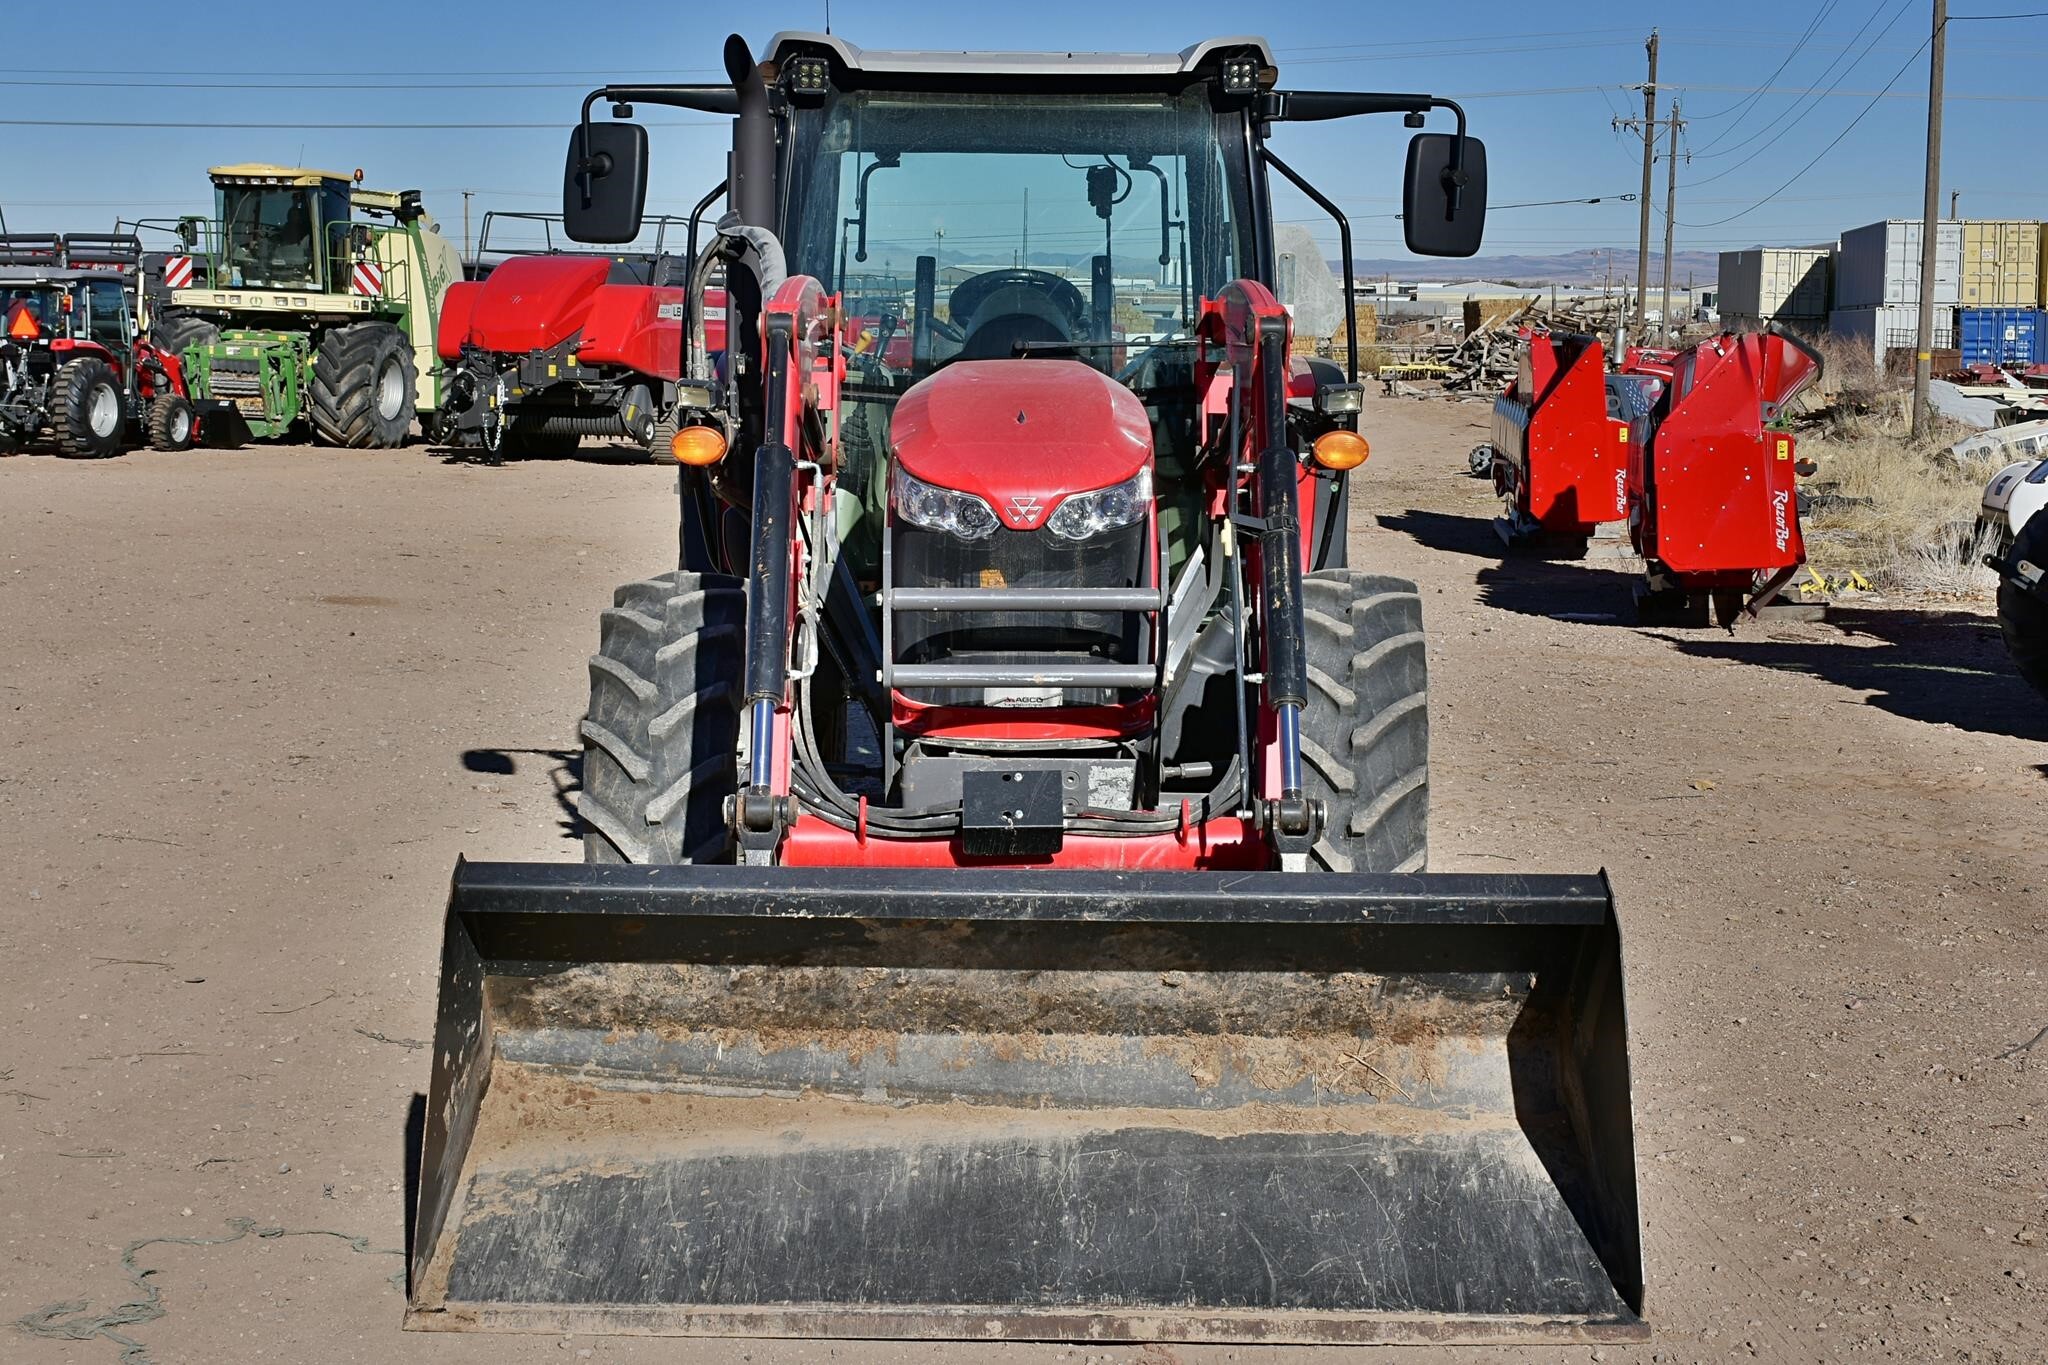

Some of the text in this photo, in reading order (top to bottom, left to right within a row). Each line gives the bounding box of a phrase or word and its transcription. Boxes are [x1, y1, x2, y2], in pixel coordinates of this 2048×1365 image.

[672, 306, 682, 317] LB
[1614, 468, 1627, 515] RazorBar
[1772, 489, 1790, 554] RazorBar
